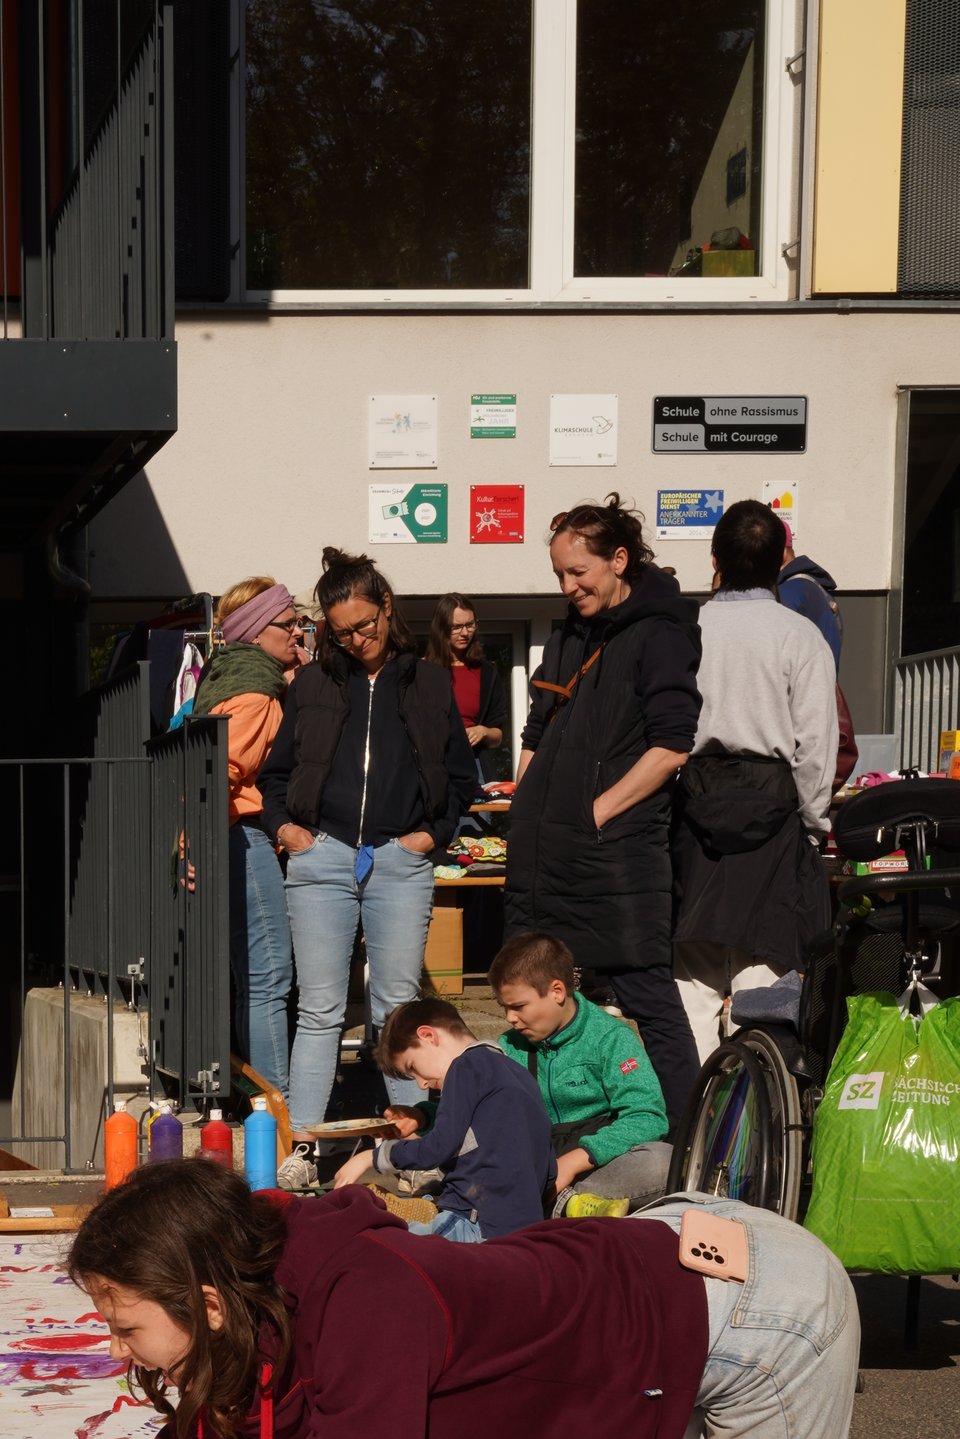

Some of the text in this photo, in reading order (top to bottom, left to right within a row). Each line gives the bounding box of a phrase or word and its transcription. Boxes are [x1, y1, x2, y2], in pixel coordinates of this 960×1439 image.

[662, 406, 799, 417] Schule ohne Rassismus
[662, 432, 778, 445] Schule mit Courage
[660, 517, 685, 525] TRÄGER
[846, 1081, 877, 1101] SZ
